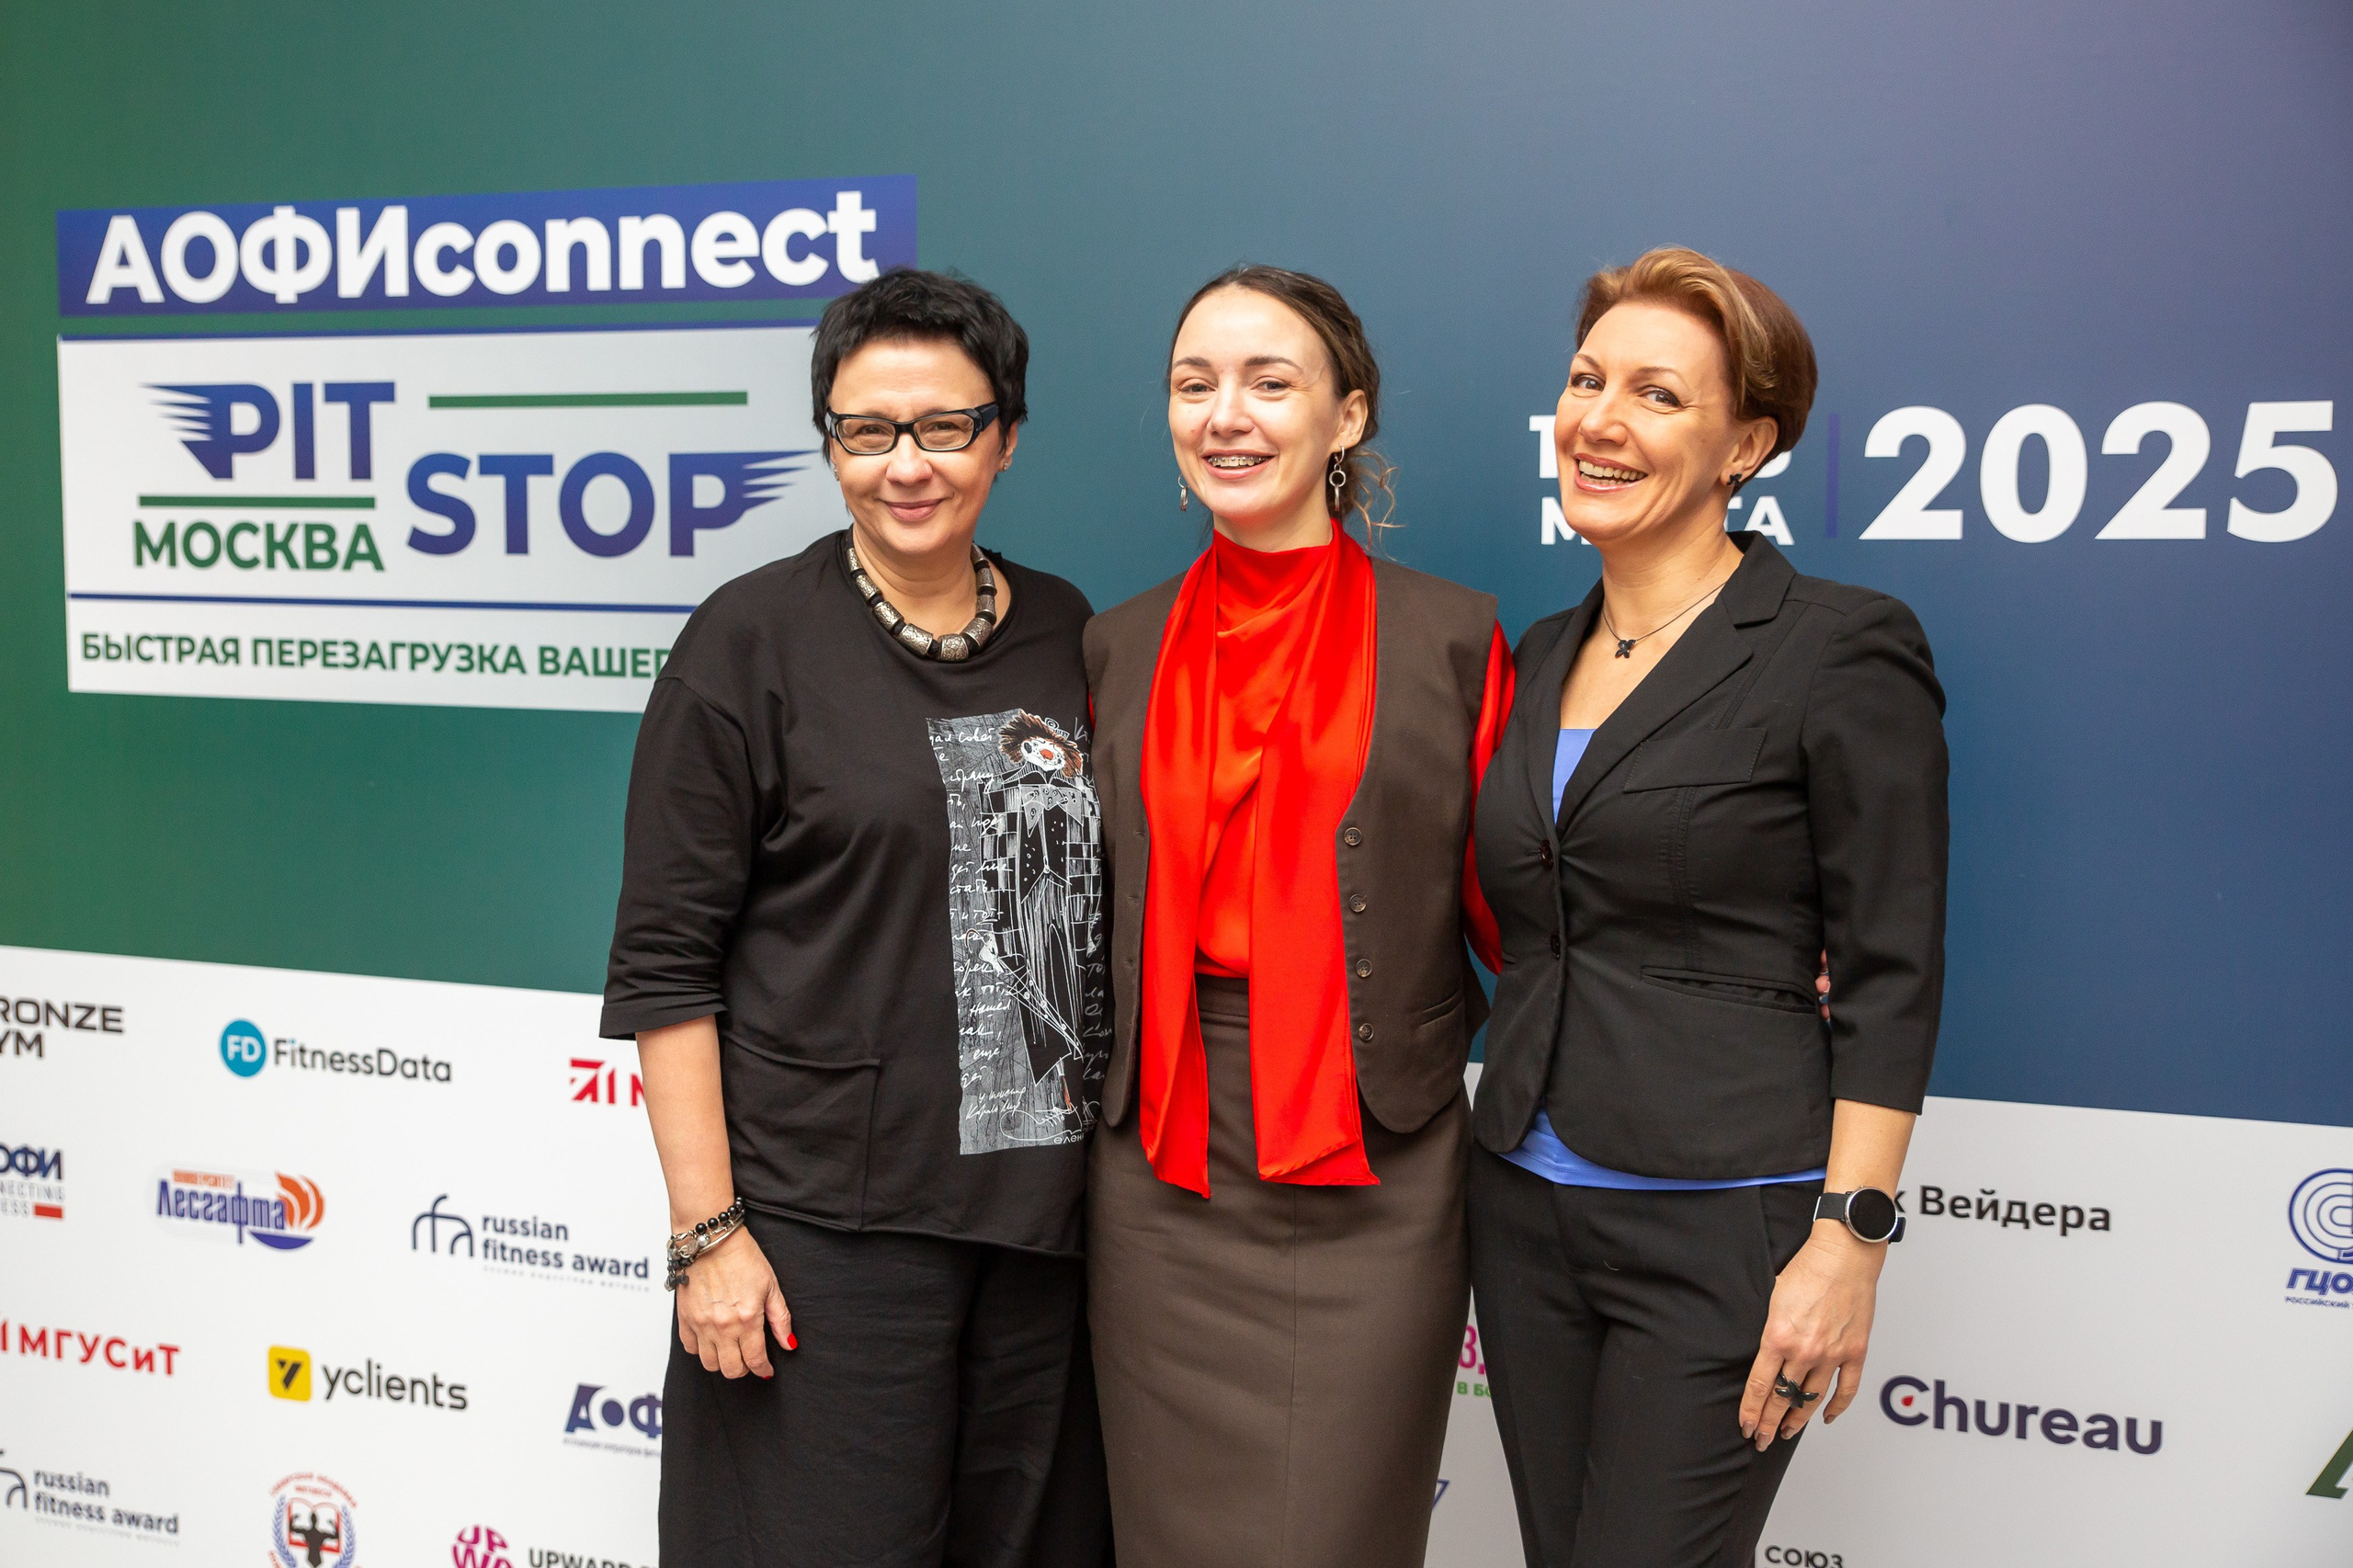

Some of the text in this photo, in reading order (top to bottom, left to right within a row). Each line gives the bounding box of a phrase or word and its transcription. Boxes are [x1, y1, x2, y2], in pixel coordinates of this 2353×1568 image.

[145, 381, 396, 481] PIT
[1859, 401, 2338, 544] 2025
[406, 450, 819, 558] STOP
[134, 520, 386, 572] МОСКВА
[81, 633, 241, 666] БЫСТРАЯ
[252, 638, 528, 676] ПЕРЕЗАГРУЗКА
[274, 1038, 452, 1084] FitnessData
[482, 1215, 570, 1241] russian
[1920, 1185, 2111, 1236] Вейдера
[482, 1238, 564, 1268] fitness
[571, 1256, 650, 1279] award
[18, 1324, 181, 1377] МГУСиТ
[322, 1358, 469, 1411] yclients
[1880, 1375, 2164, 1455] Chureau
[33, 1470, 110, 1496] russian
[33, 1492, 106, 1522] fitness
[111, 1508, 180, 1534] award
